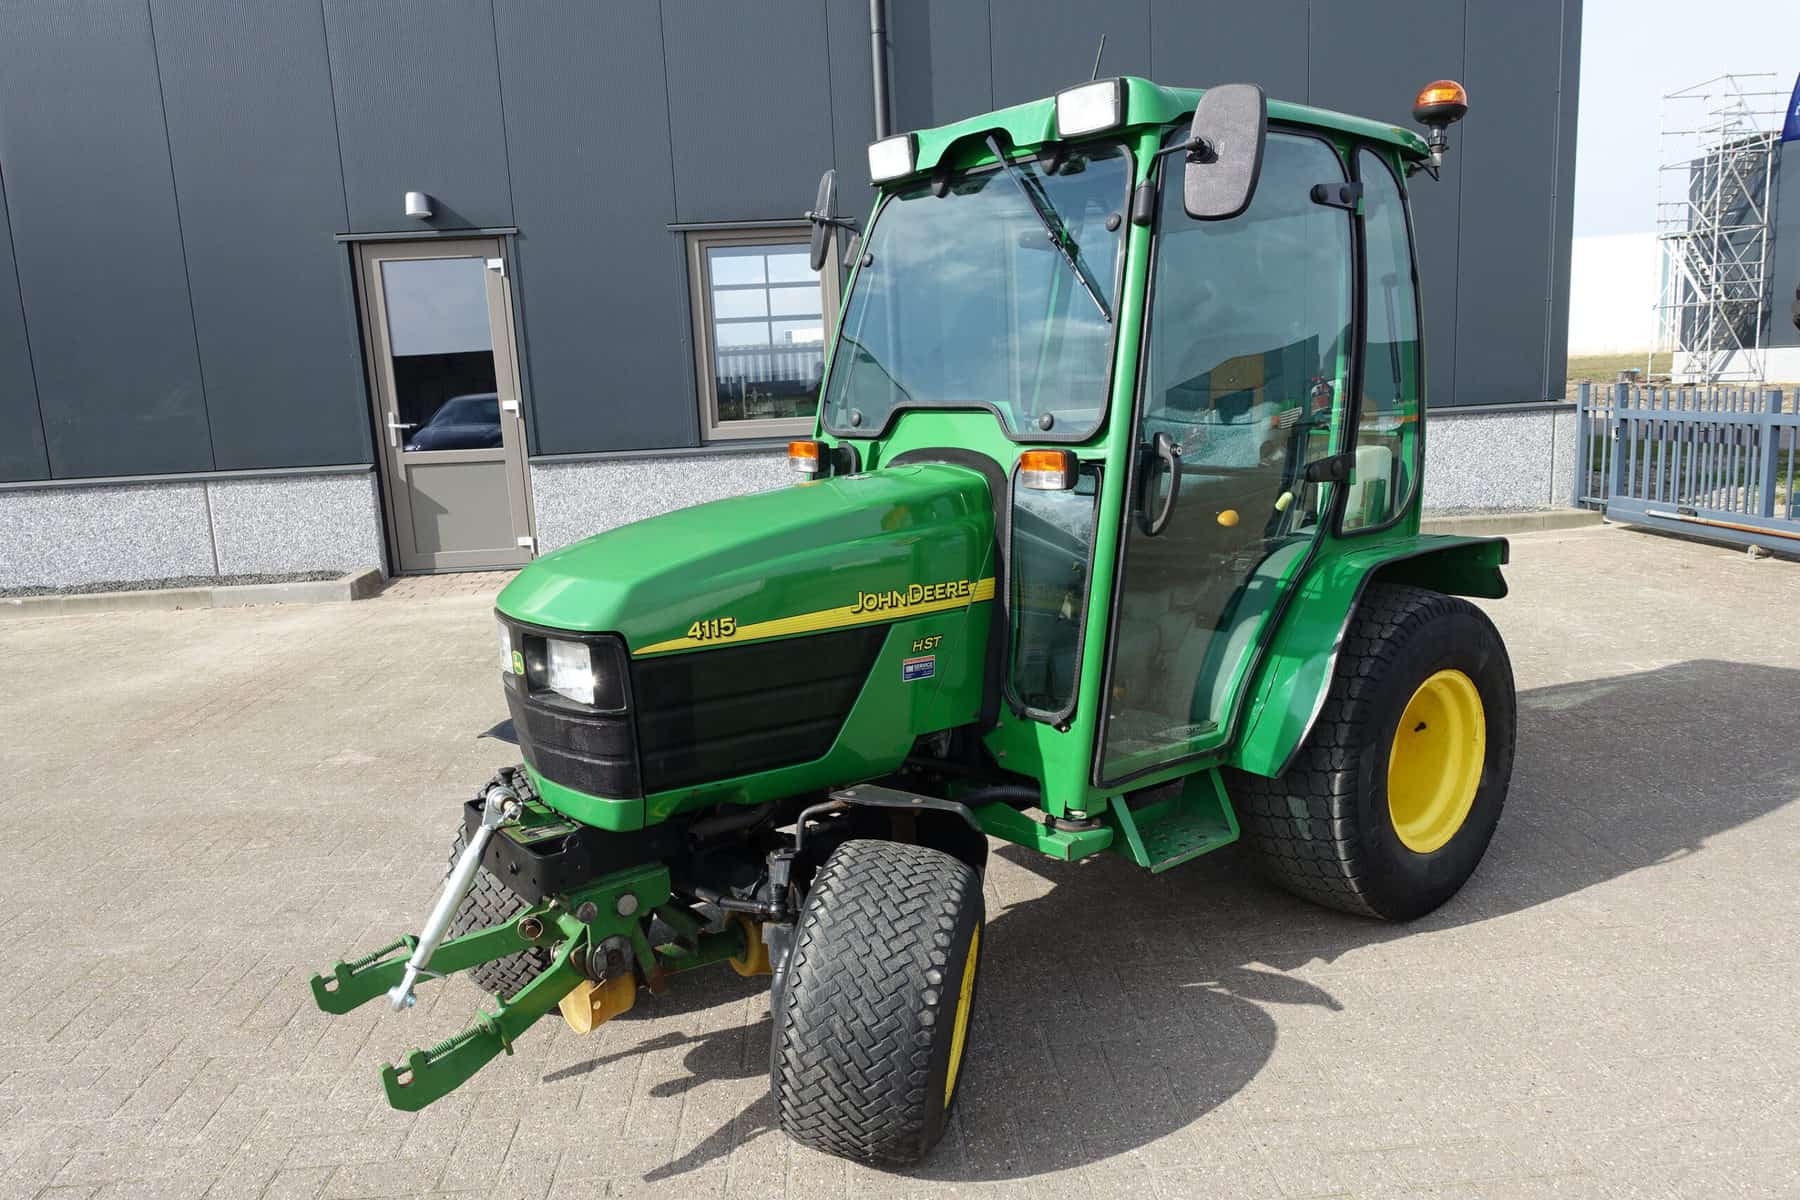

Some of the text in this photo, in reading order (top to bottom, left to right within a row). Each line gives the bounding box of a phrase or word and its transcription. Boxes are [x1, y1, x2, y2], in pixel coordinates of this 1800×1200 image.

[851, 579, 970, 614] JOHN DEERE
[687, 617, 736, 640] 4115
[912, 635, 943, 652] HST
